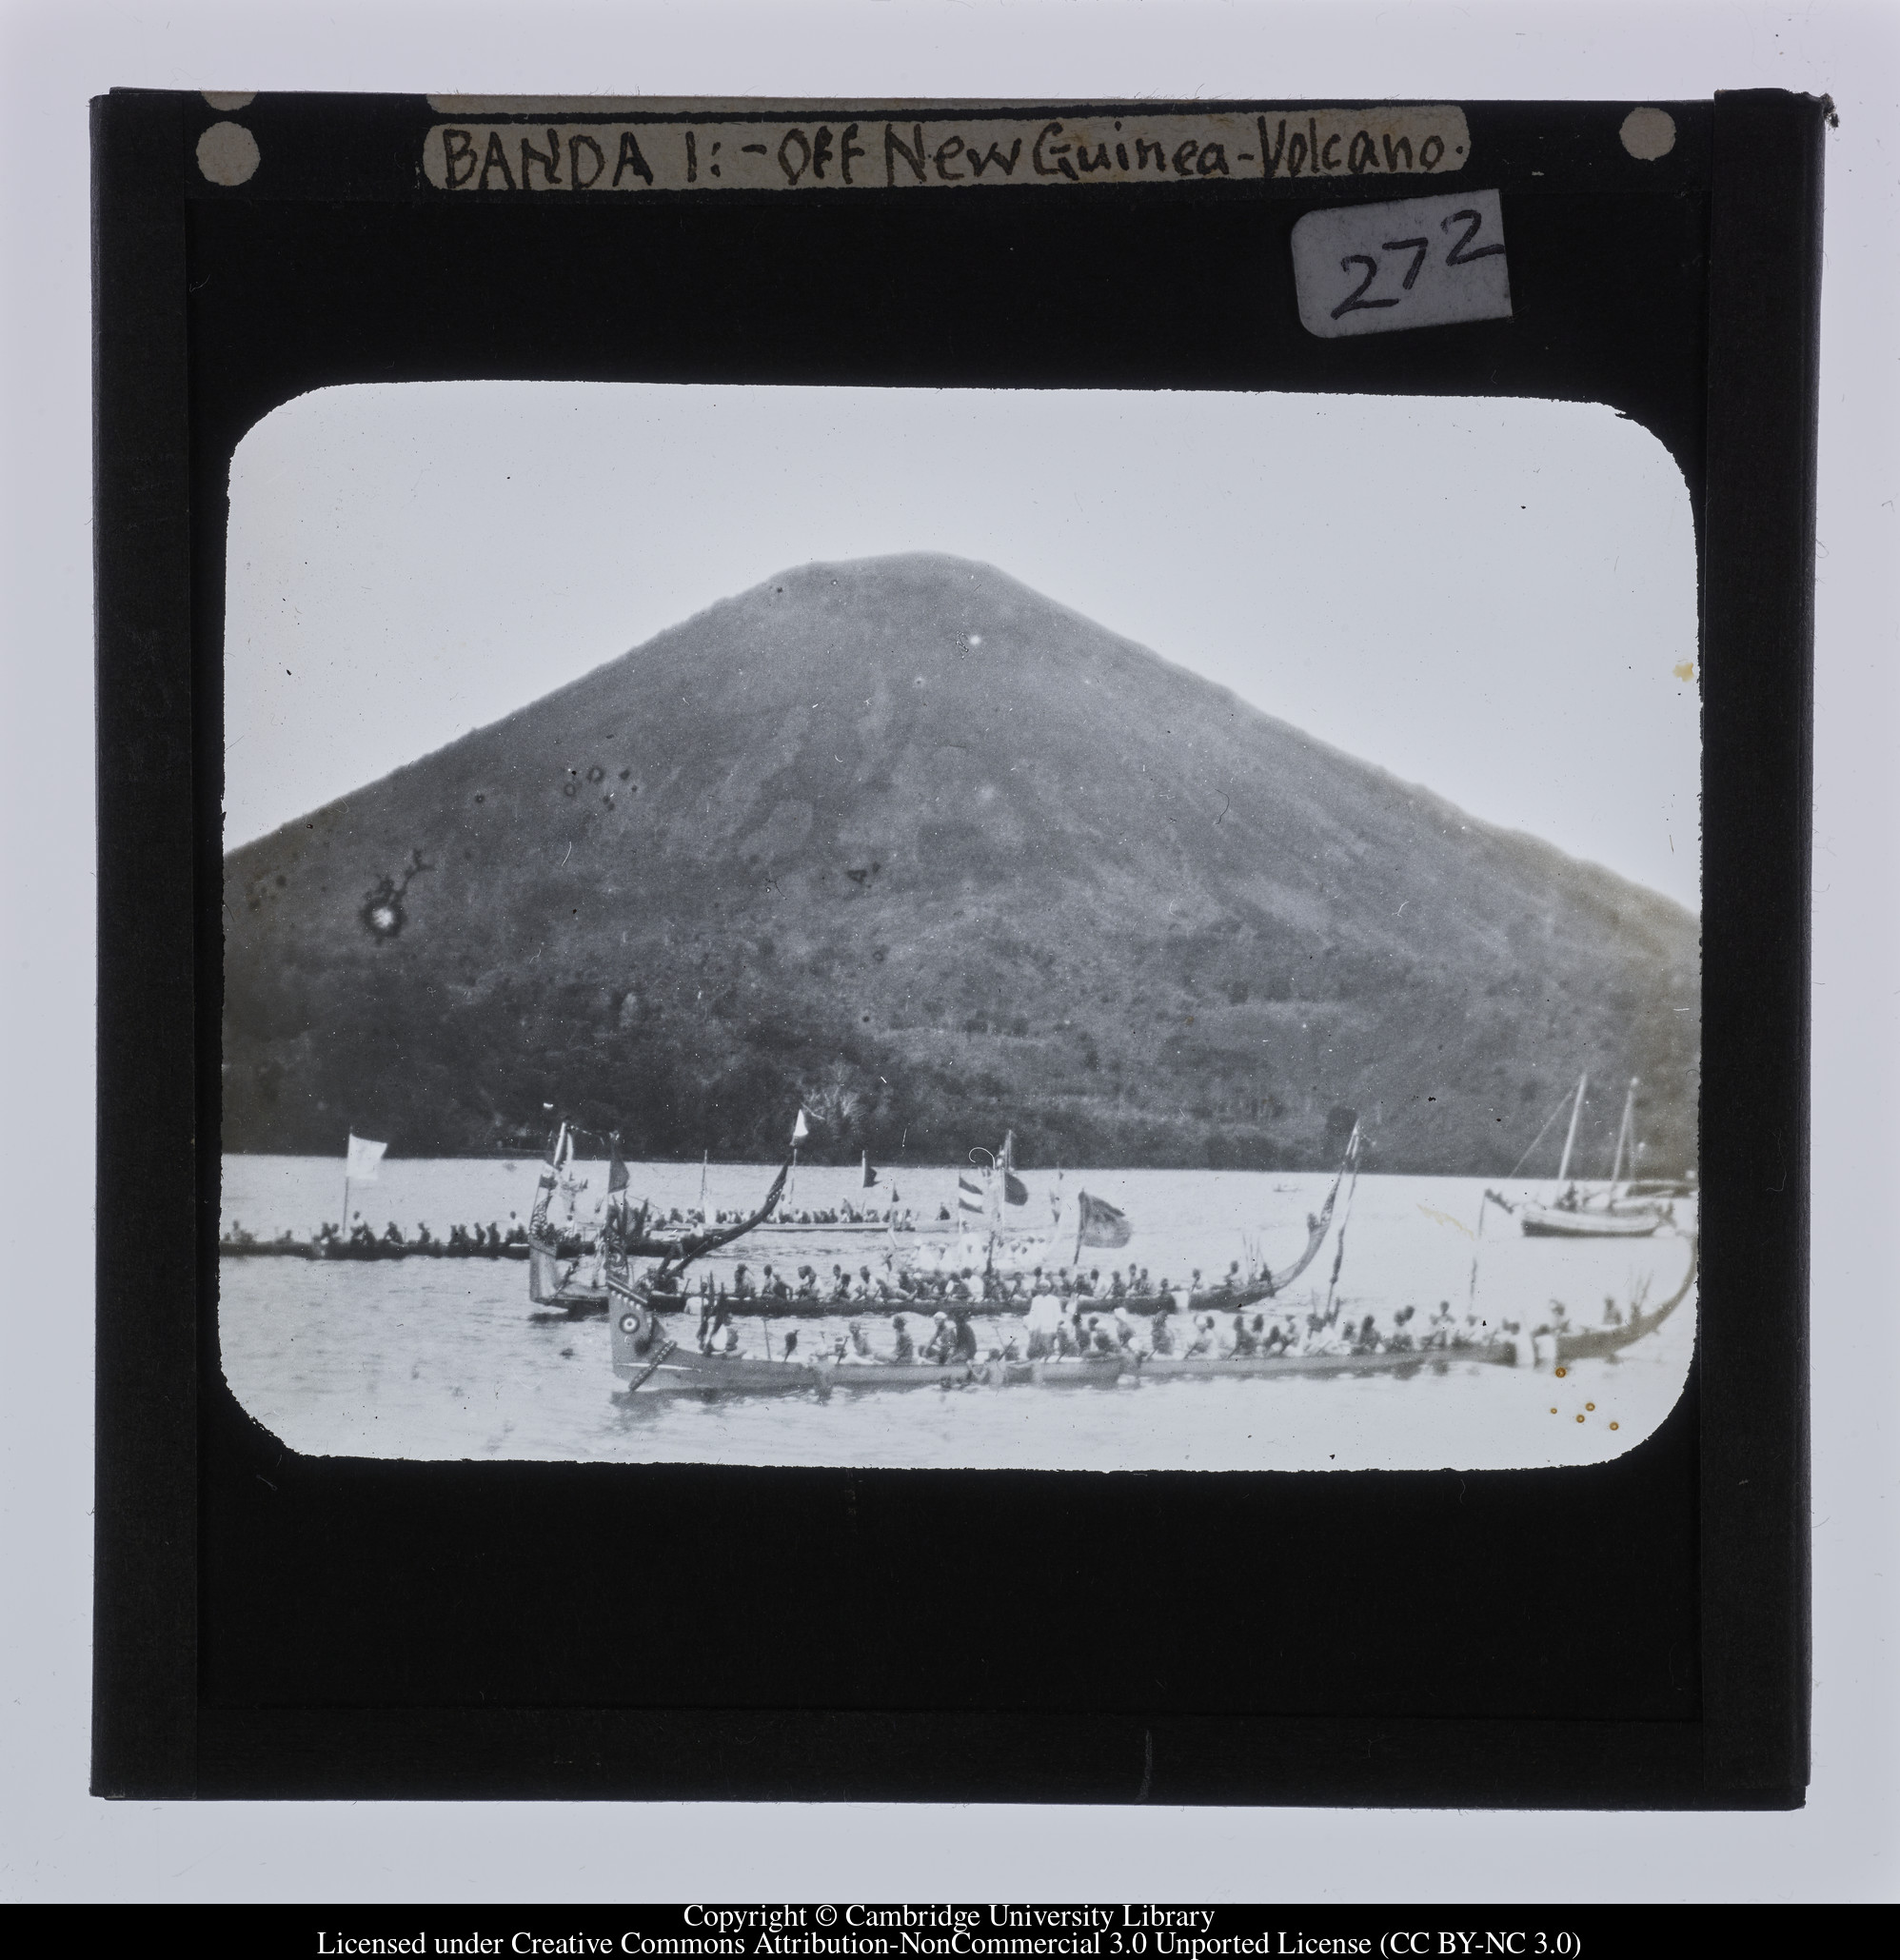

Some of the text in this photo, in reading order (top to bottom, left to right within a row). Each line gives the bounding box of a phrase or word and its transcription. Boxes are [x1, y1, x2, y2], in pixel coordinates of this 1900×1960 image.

[443, 129, 654, 189] BANDA
[884, 123, 1021, 188] New
[1331, 209, 1505, 320] 272
